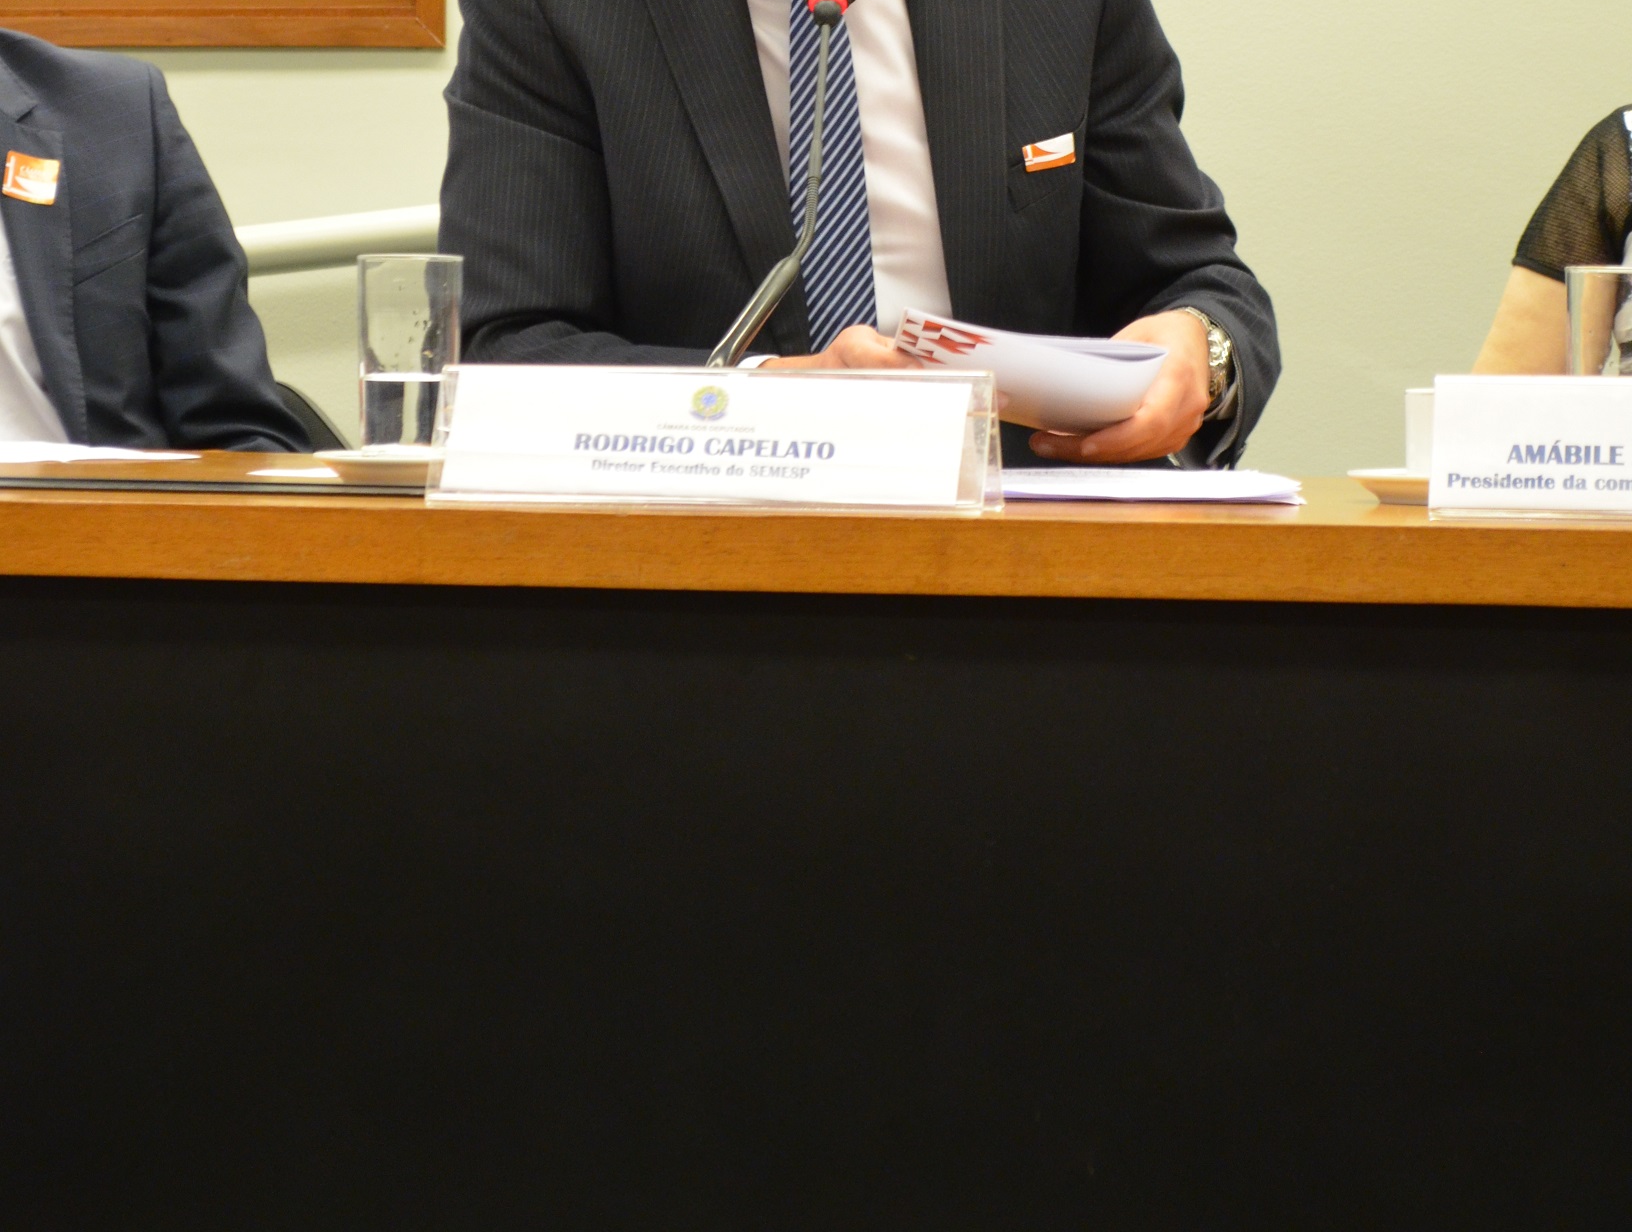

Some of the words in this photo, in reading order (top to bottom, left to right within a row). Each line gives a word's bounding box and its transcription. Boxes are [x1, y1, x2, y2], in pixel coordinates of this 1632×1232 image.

[574, 433, 694, 455] RODRIGO
[704, 437, 835, 460] CAPELATO
[1507, 440, 1624, 466] AMÁBILE
[591, 459, 645, 472] Diretor
[650, 461, 720, 476] Executivo
[726, 464, 744, 476] do
[749, 465, 810, 479] SEMESP
[1447, 473, 1556, 490] Presidente
[1562, 474, 1588, 490] da
